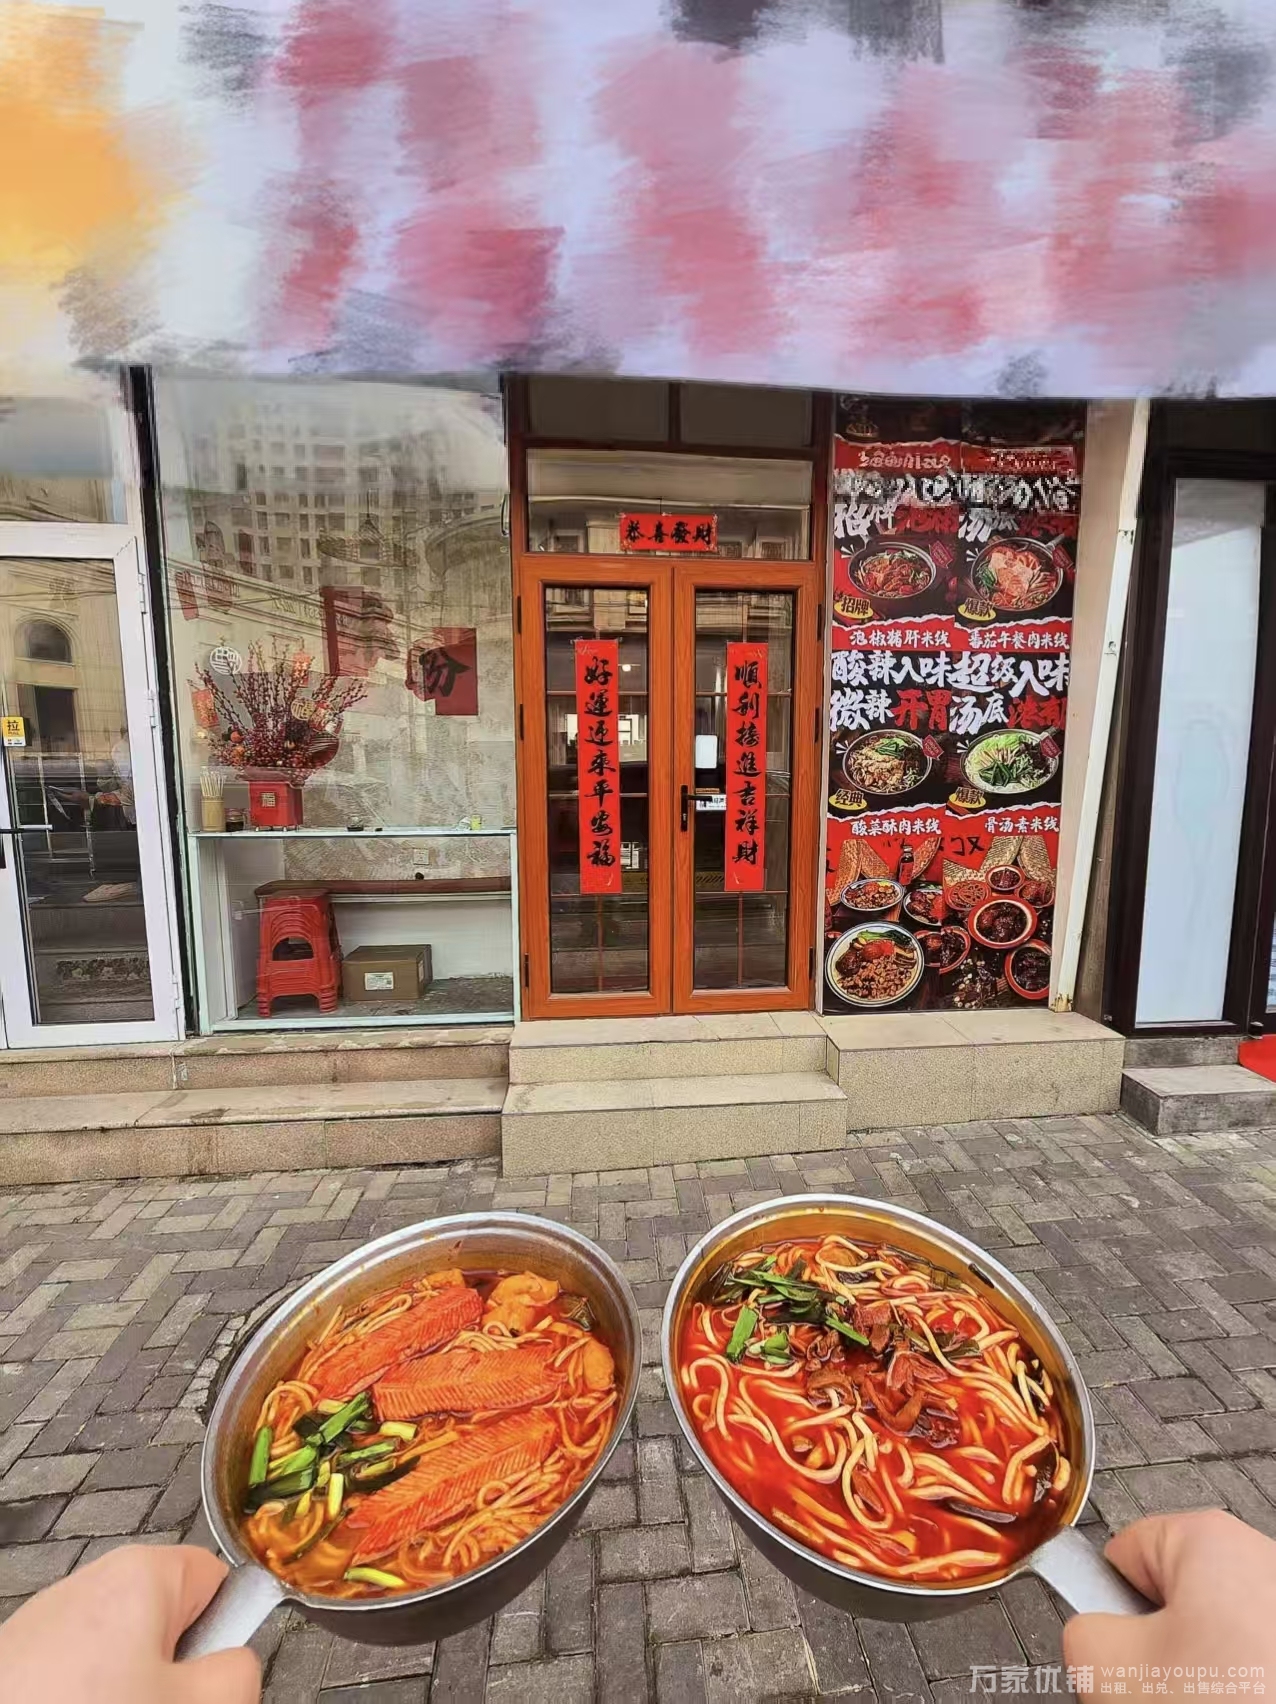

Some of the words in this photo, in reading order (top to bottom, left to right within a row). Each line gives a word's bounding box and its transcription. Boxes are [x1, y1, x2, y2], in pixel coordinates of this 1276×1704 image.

[626, 520, 712, 546] 恭喜發財
[841, 597, 871, 616] 招牌
[964, 599, 995, 619] 爆款
[850, 629, 951, 648] 泡椒猪肝米线
[968, 630, 1070, 650] 番茄午餐肉米线
[831, 650, 950, 687] 酸辣入味
[949, 651, 1069, 698] 超级入味
[830, 687, 949, 732] 微辣开胃
[7, 720, 20, 731] 拉
[836, 788, 866, 807] 经典
[955, 786, 985, 805] 爆款
[851, 818, 942, 836] 酸菜酥肉米线
[984, 816, 1060, 834] 骨汤素米线
